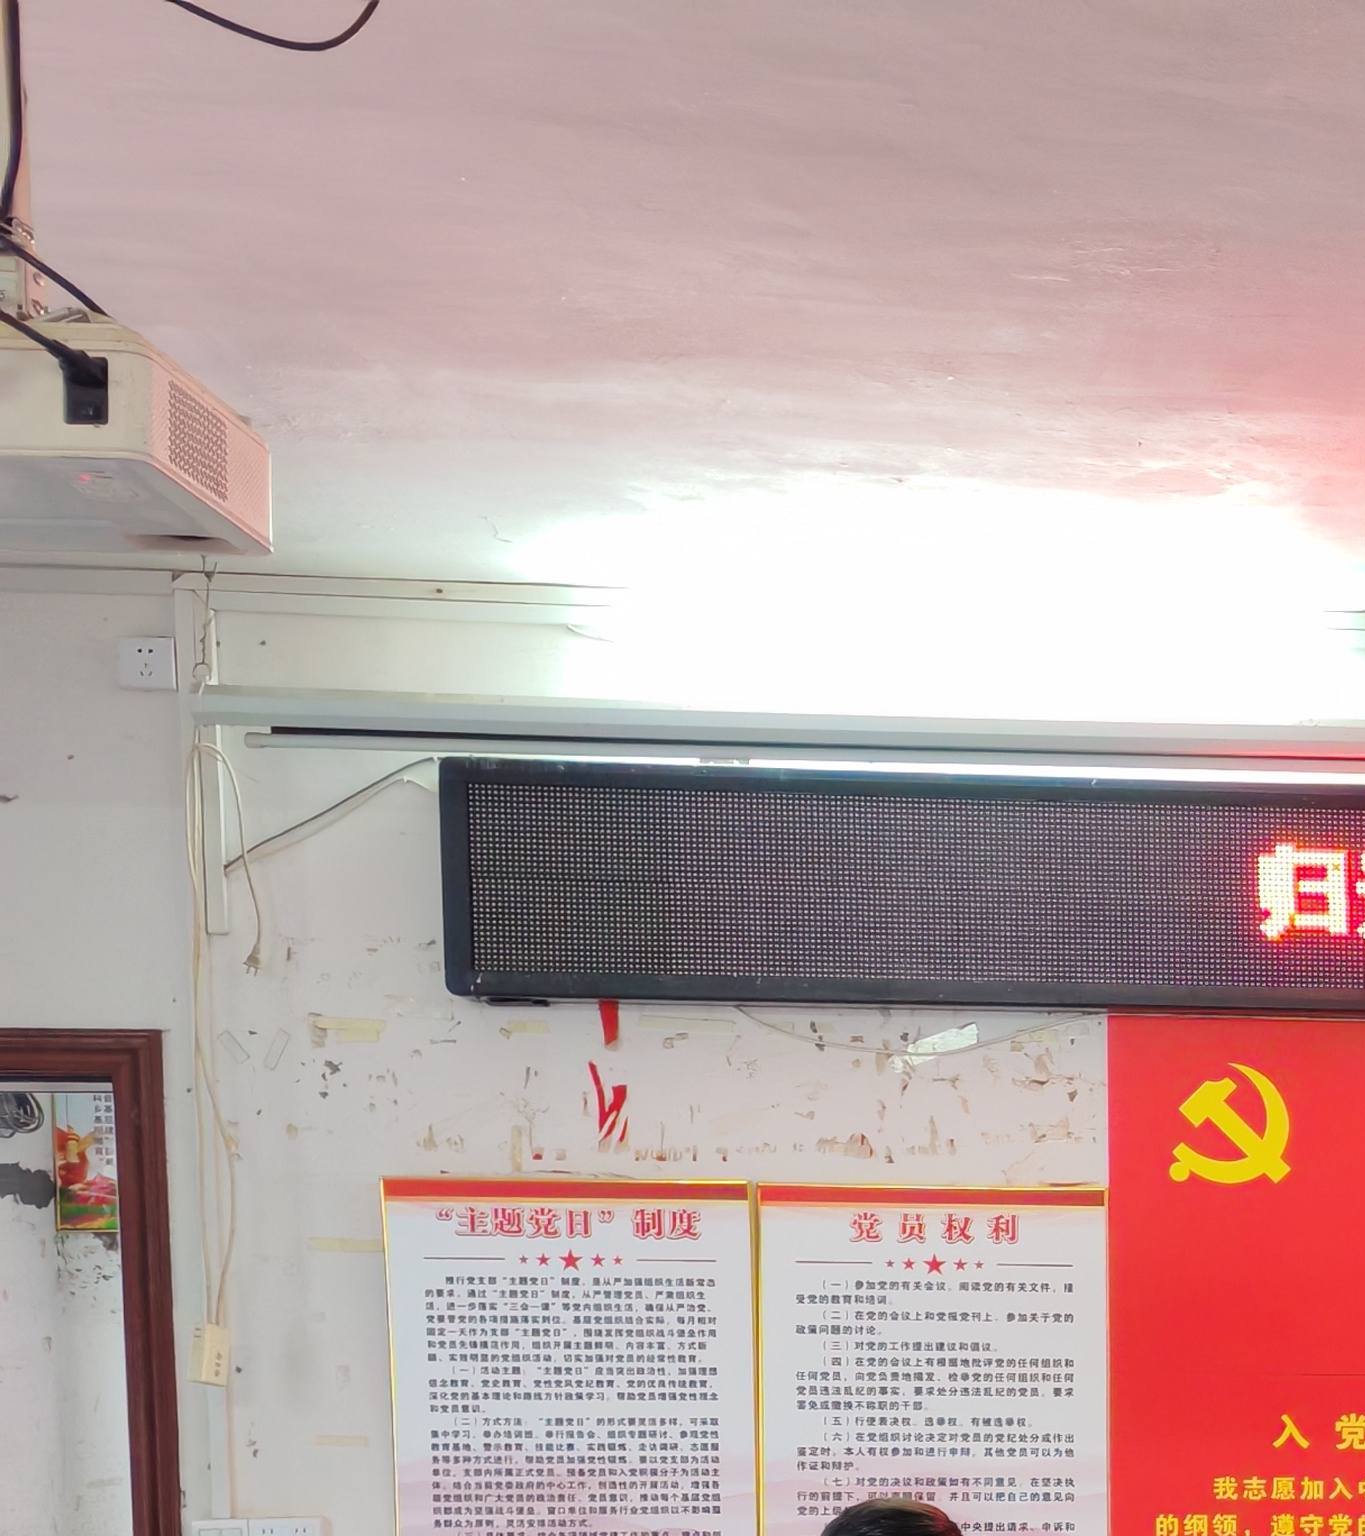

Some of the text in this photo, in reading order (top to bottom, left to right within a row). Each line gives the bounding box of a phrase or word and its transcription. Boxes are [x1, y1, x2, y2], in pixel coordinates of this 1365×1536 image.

[437, 1206, 703, 1240] “主题党日”制度
[850, 1213, 1021, 1244] 党员权利
